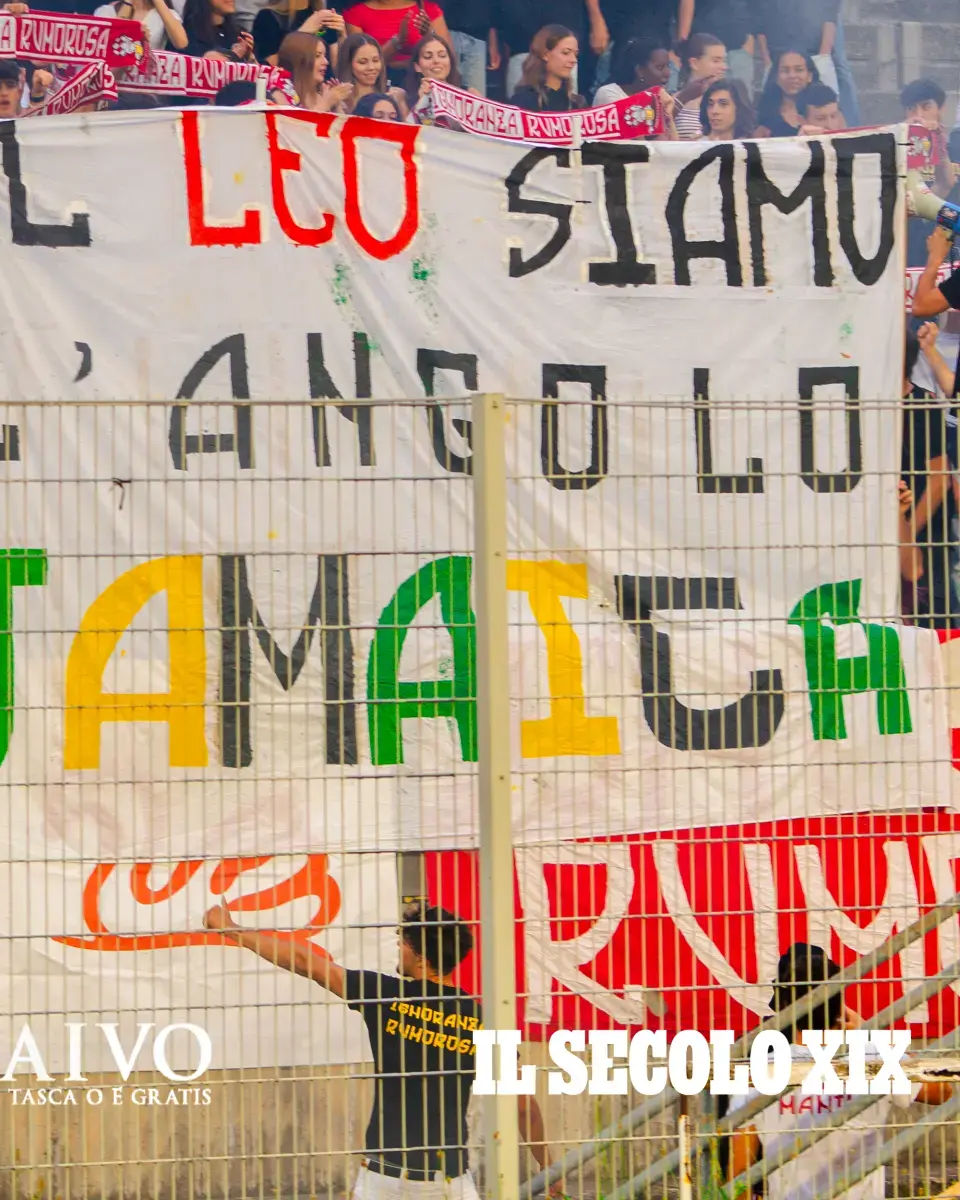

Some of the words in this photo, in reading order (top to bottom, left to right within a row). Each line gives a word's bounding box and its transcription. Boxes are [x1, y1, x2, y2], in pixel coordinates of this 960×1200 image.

[178, 109, 421, 260] LEO
[504, 132, 897, 288] SIAMO
[389, 1001, 485, 1032] IGNORANZ
